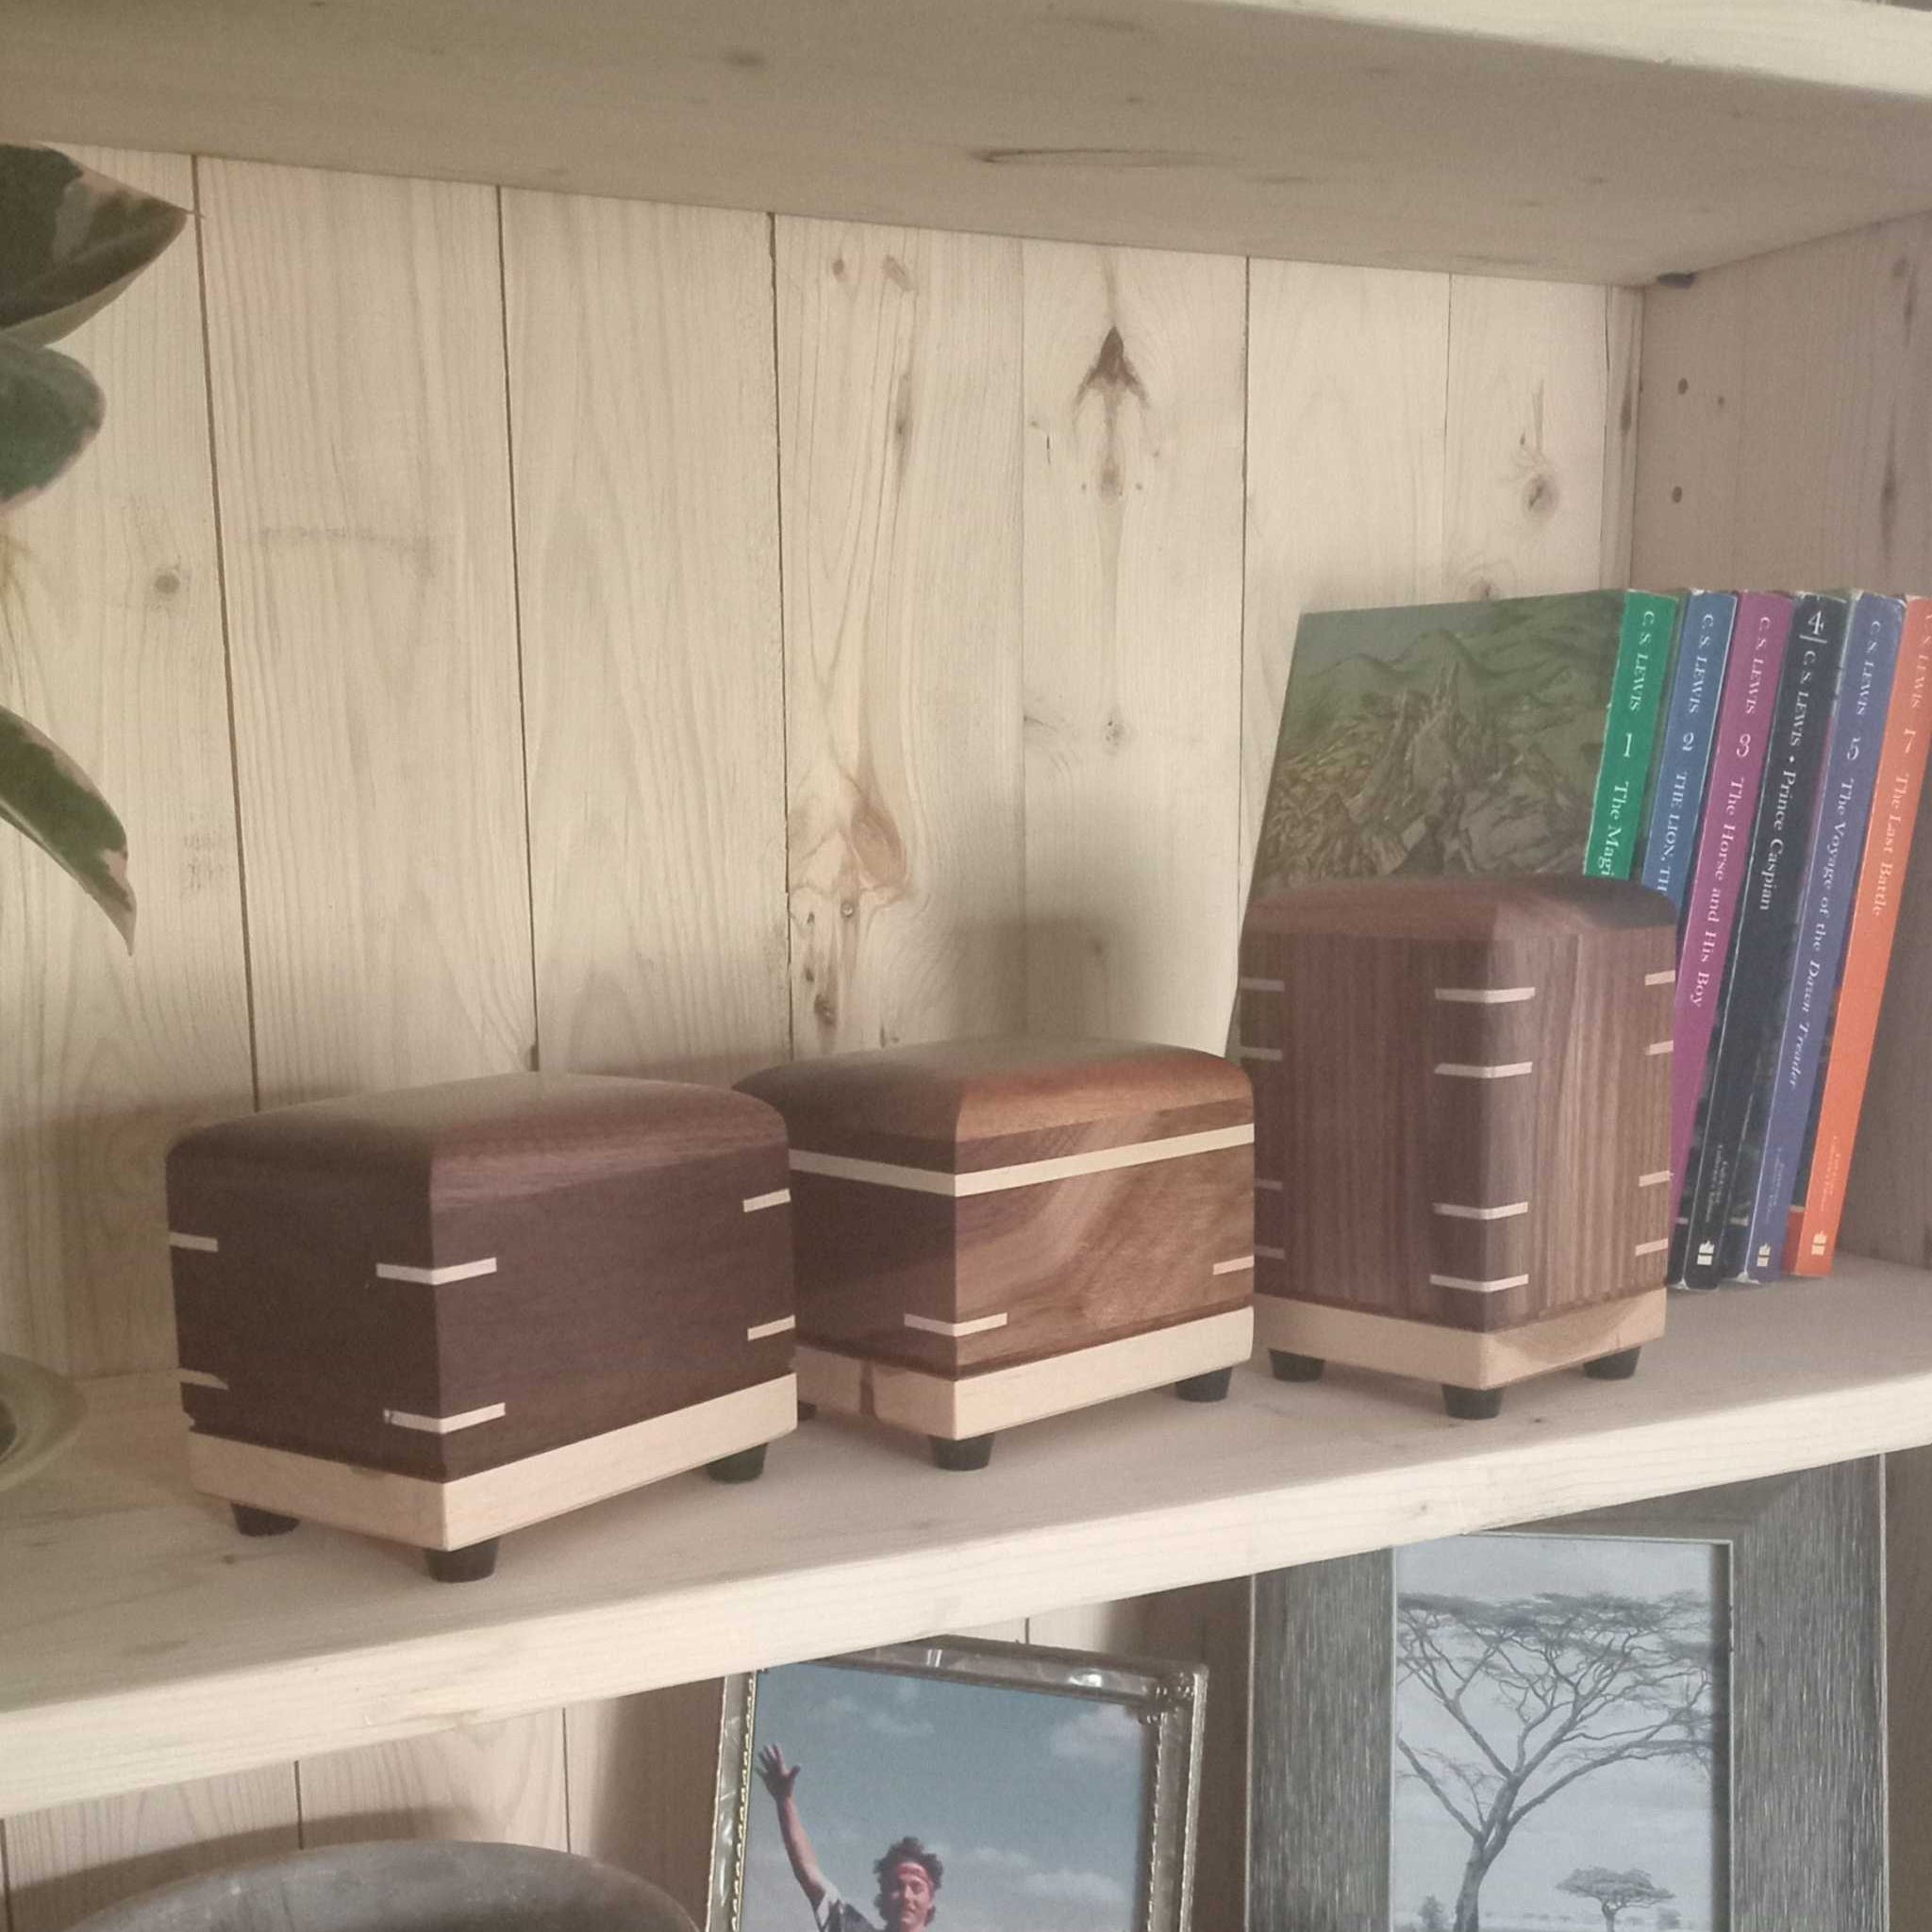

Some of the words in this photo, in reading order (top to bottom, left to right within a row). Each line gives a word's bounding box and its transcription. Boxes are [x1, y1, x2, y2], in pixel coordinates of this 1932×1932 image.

[1807, 609, 1824, 637] 4
[1630, 653, 1649, 713] LEWIS
[1689, 656, 1707, 714] LEWIS
[1746, 658, 1764, 714] LEWIS
[1857, 660, 1874, 716] LEWIS
[1790, 691, 1808, 747] LEWIS
[1624, 732, 1632, 758] 1
[1682, 732, 1694, 752] 2
[1736, 733, 1751, 758] 3
[1846, 737, 1861, 761] 5
[1610, 781, 1629, 820] The
[1671, 771, 1687, 809] THE
[1726, 776, 1744, 816] The
[1774, 769, 1796, 831] Prince
[1837, 776, 1855, 816] The
[1891, 773, 1909, 809] The
[1660, 814, 1680, 861] LION,
[1715, 824, 1736, 881] Horse
[1883, 814, 1902, 854] Last
[1759, 838, 1785, 911] Caspian
[1823, 821, 1846, 891] Voyage
[1707, 888, 1721, 923] and
[1819, 896, 1830, 919] of
[1872, 861, 1893, 917] Battle
[1701, 930, 1717, 963] His
[1812, 923, 1826, 953] the
[1690, 971, 1709, 1008] Boy
[1801, 958, 1821, 1014] Dawn
[1789, 1022, 1810, 1089] Treader
